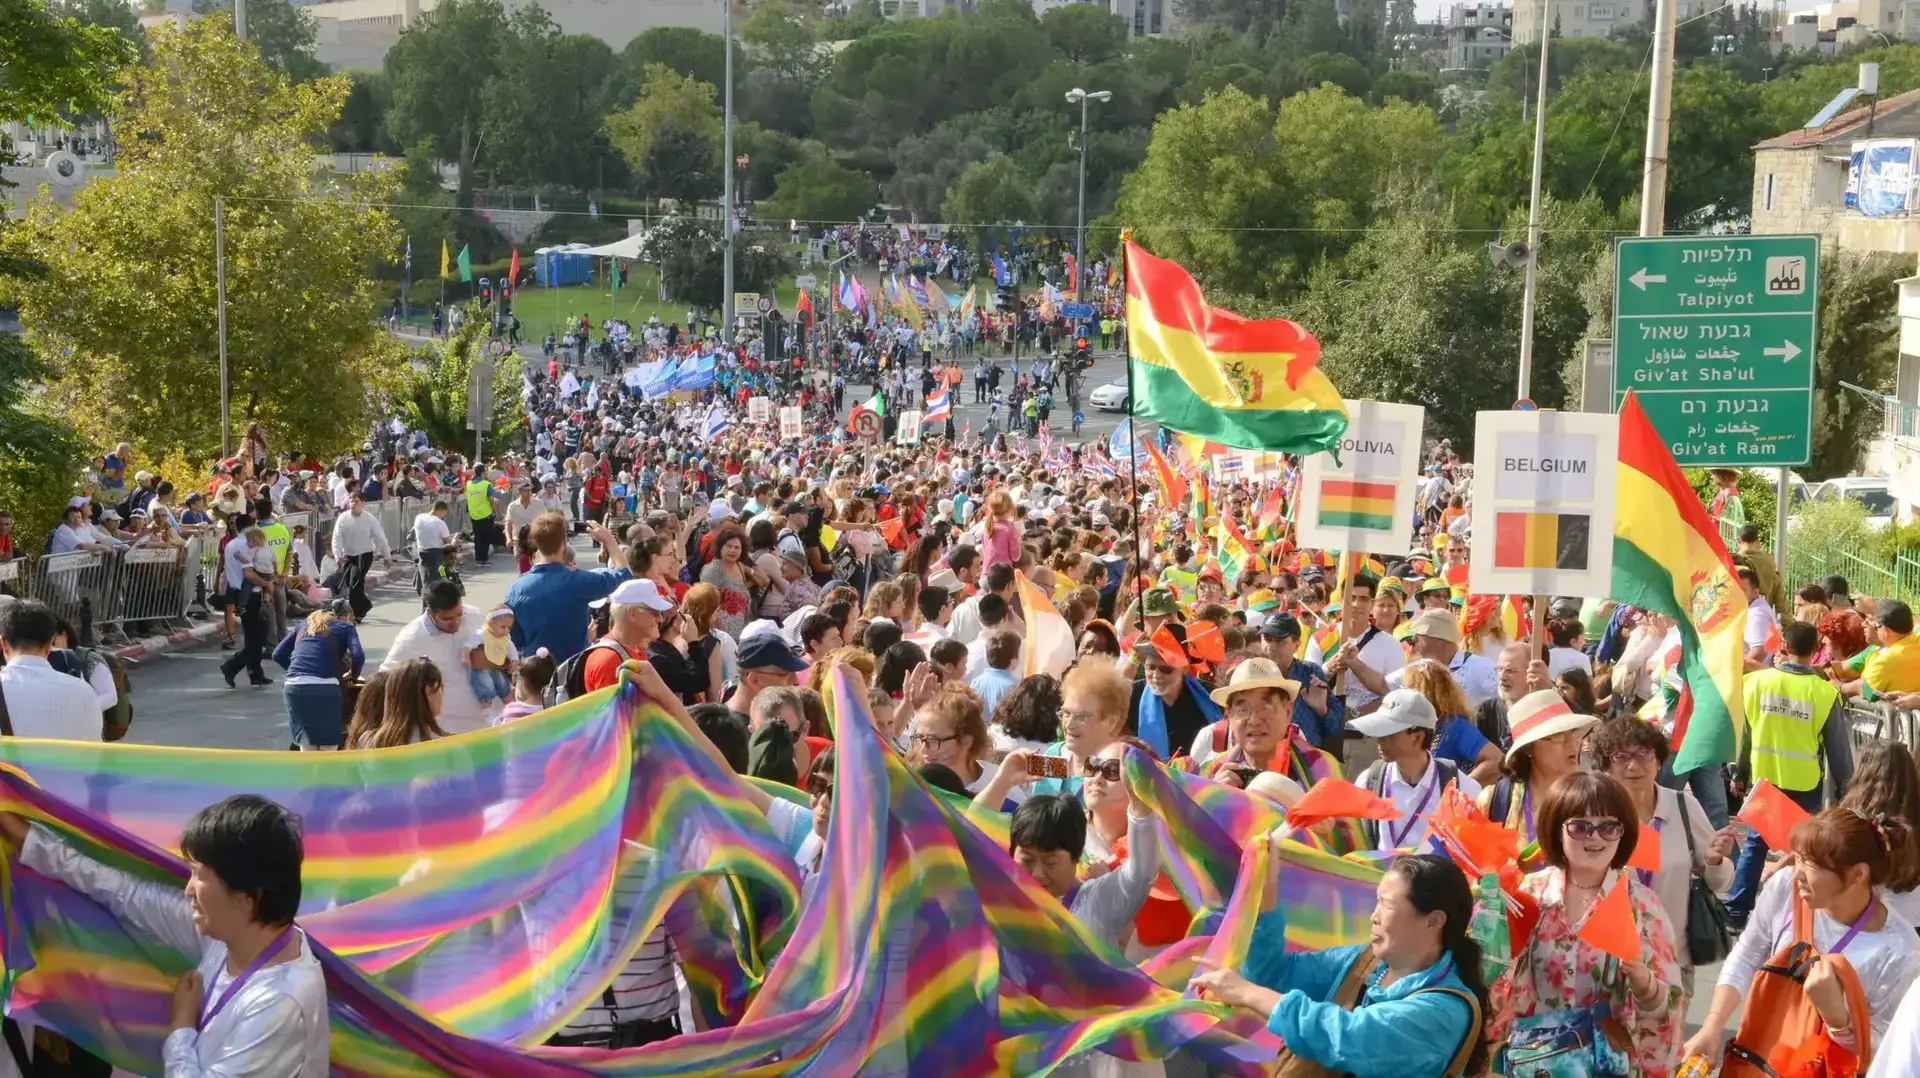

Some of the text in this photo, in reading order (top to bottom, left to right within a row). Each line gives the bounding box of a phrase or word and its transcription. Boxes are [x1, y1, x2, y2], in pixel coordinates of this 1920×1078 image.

[1681, 245, 1752, 263] תלפיות
[1677, 292, 1754, 308] Talpiyot
[1639, 323, 1751, 340] גבעת שאול
[1634, 367, 1755, 382] Giv'at Sha'ul
[1681, 399, 1769, 415] גבעת רם
[1672, 441, 1777, 456] Giv'at Ram
[1504, 458, 1587, 474] BELGIUM
